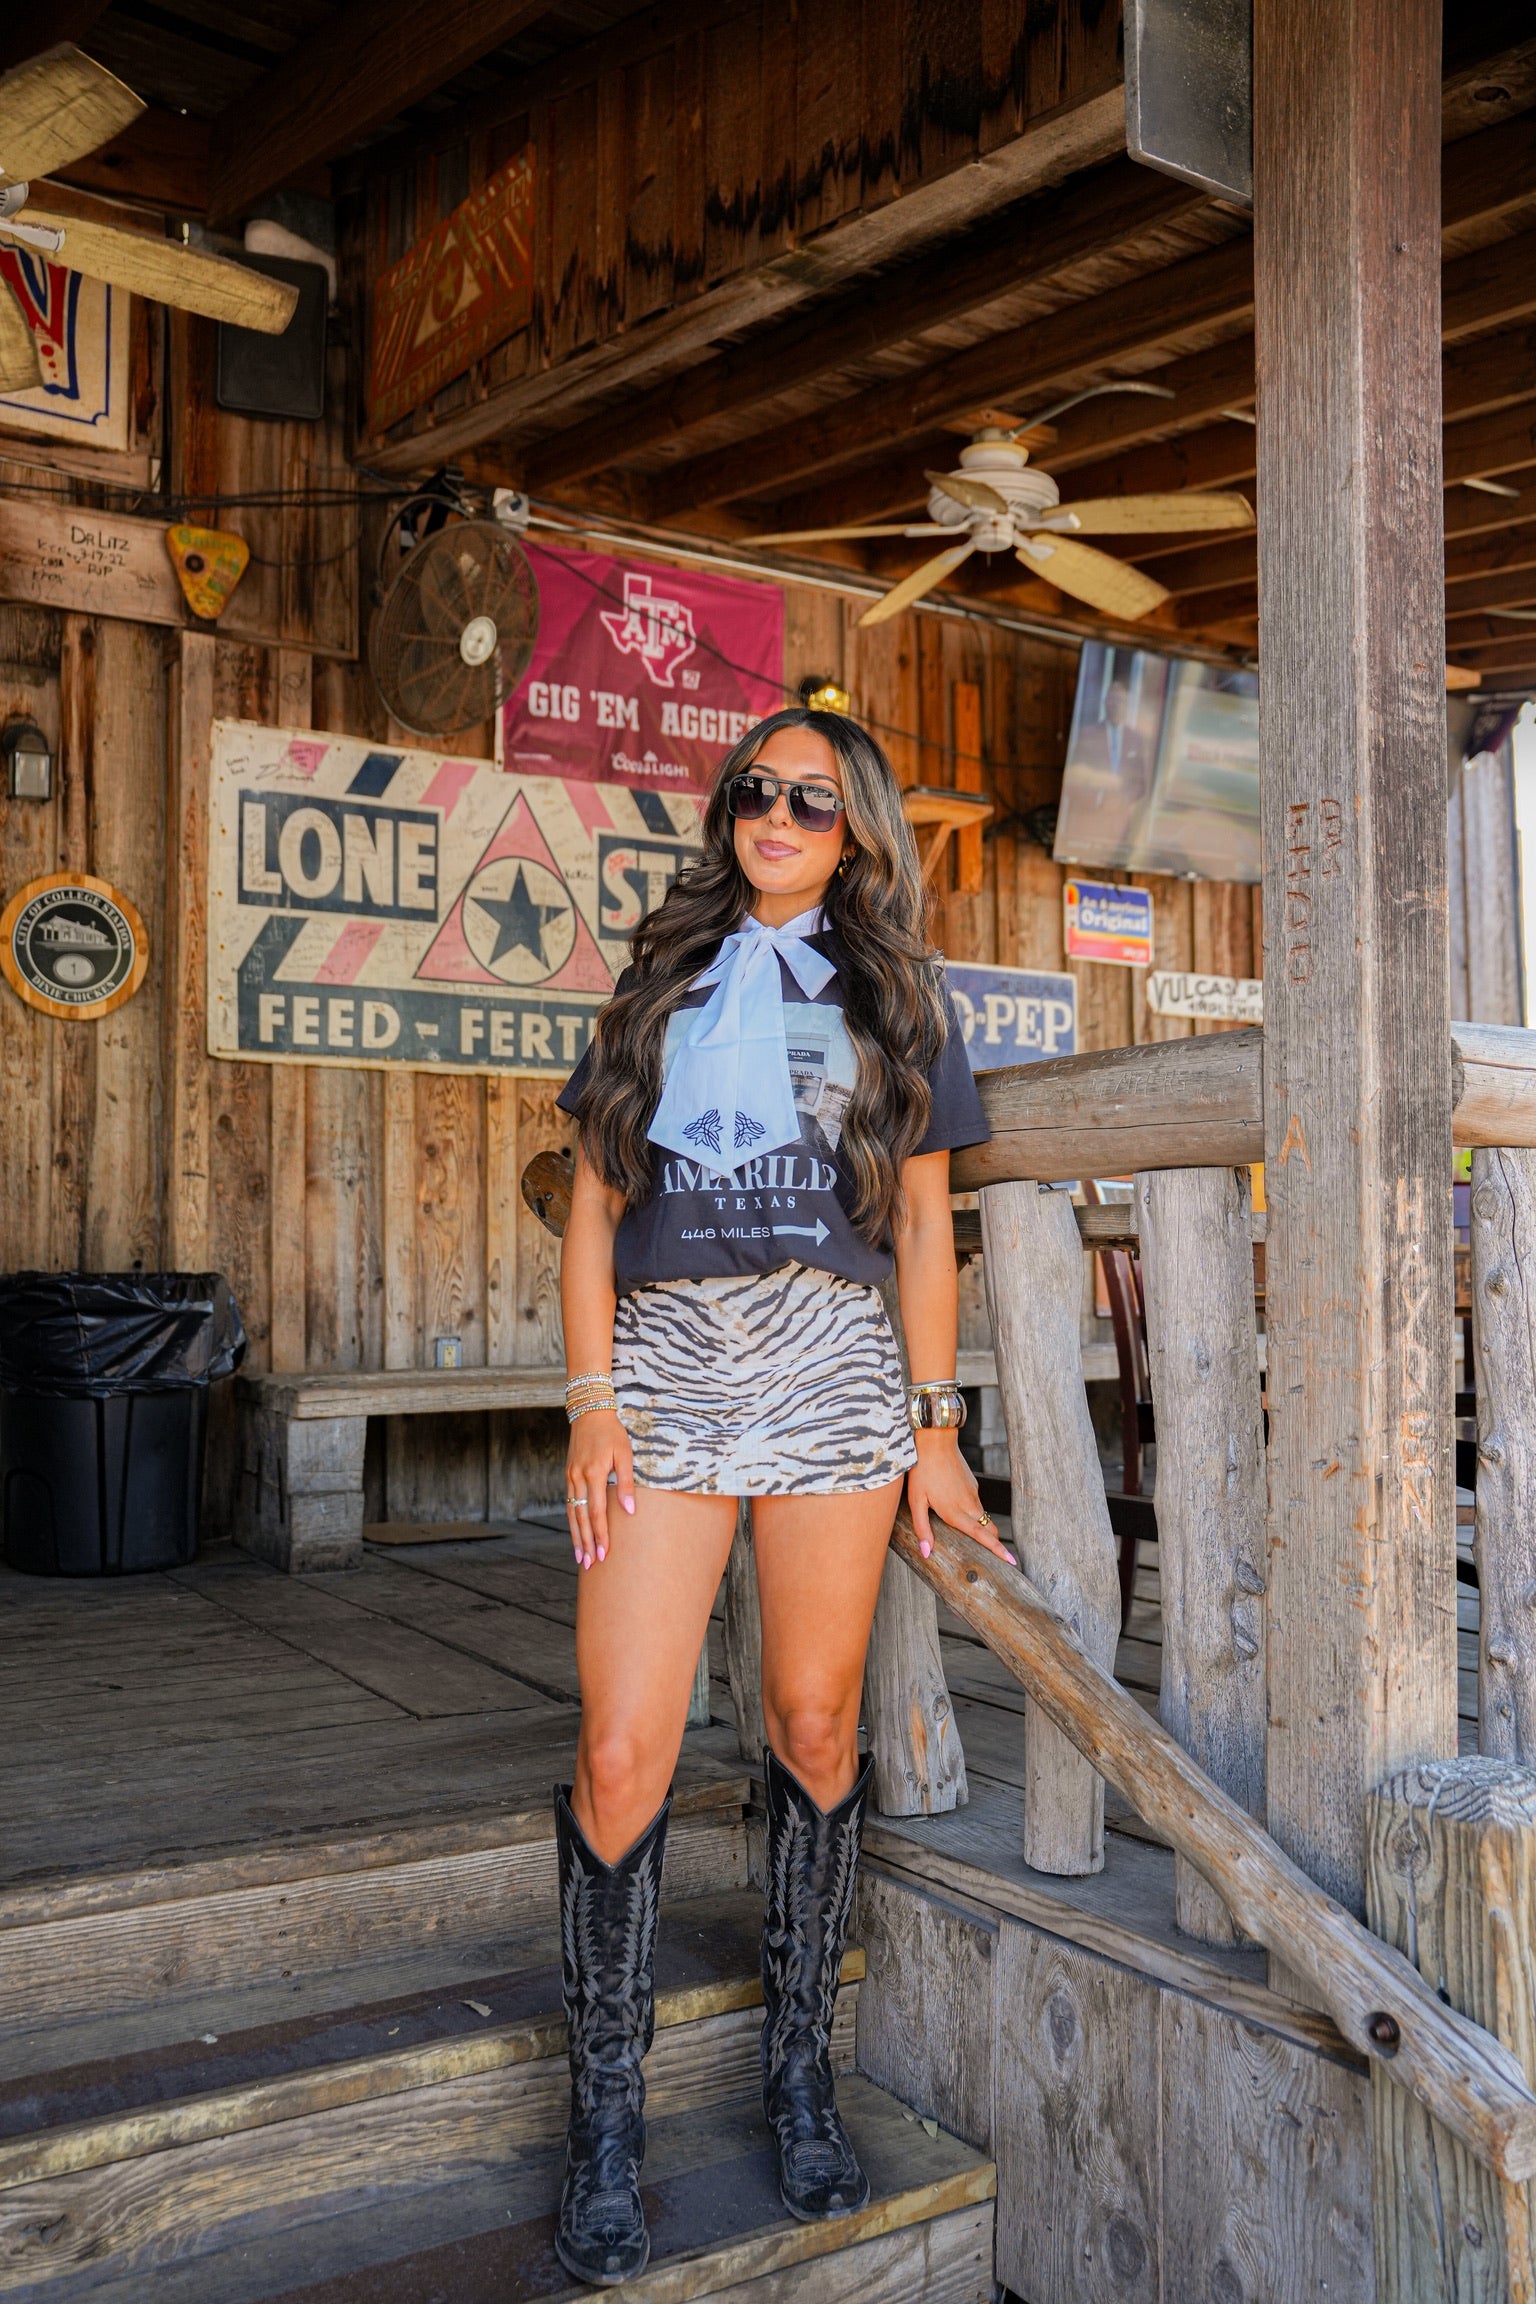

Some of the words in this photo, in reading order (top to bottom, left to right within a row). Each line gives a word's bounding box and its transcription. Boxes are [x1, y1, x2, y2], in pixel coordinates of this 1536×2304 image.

[527, 681, 580, 722] GIG
[590, 691, 640, 731] 'EM
[243, 801, 437, 911] LONE
[43, 890, 100, 906] COLLEGE
[101, 902, 132, 950] STATION
[1081, 909, 1148, 932] Original
[64, 980, 117, 1002] CHICKEN
[258, 993, 401, 1049] FEED
[714, 1196, 796, 1211] TEXAS
[681, 1228, 717, 1240] 446
[721, 1226, 771, 1239] MILES
